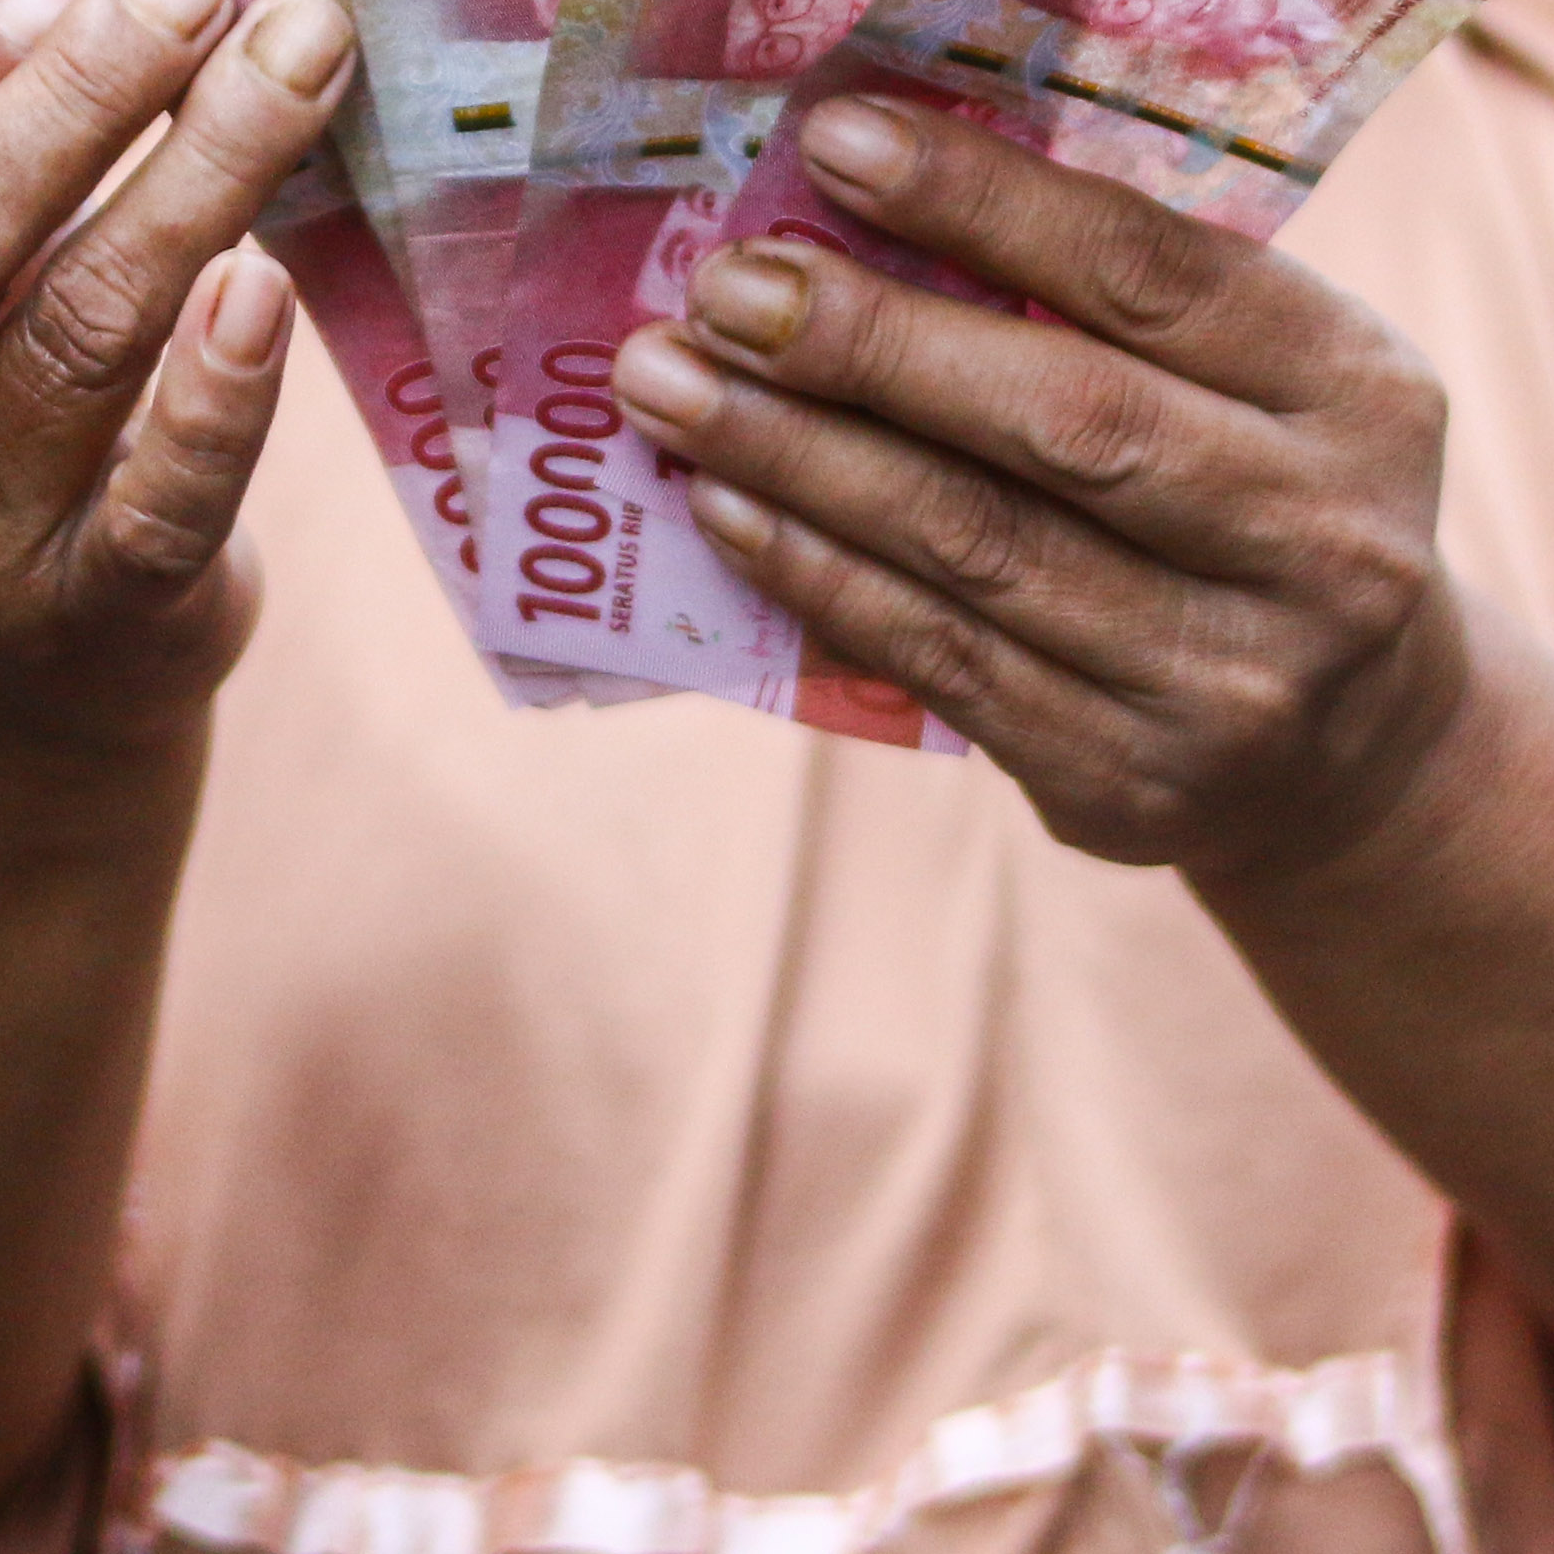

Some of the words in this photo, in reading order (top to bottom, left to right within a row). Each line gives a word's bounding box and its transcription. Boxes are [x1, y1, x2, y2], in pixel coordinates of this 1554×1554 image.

[516, 339, 623, 623] 100000
[622, 501, 643, 538] RIB
[609, 542, 641, 634] SERATUS
